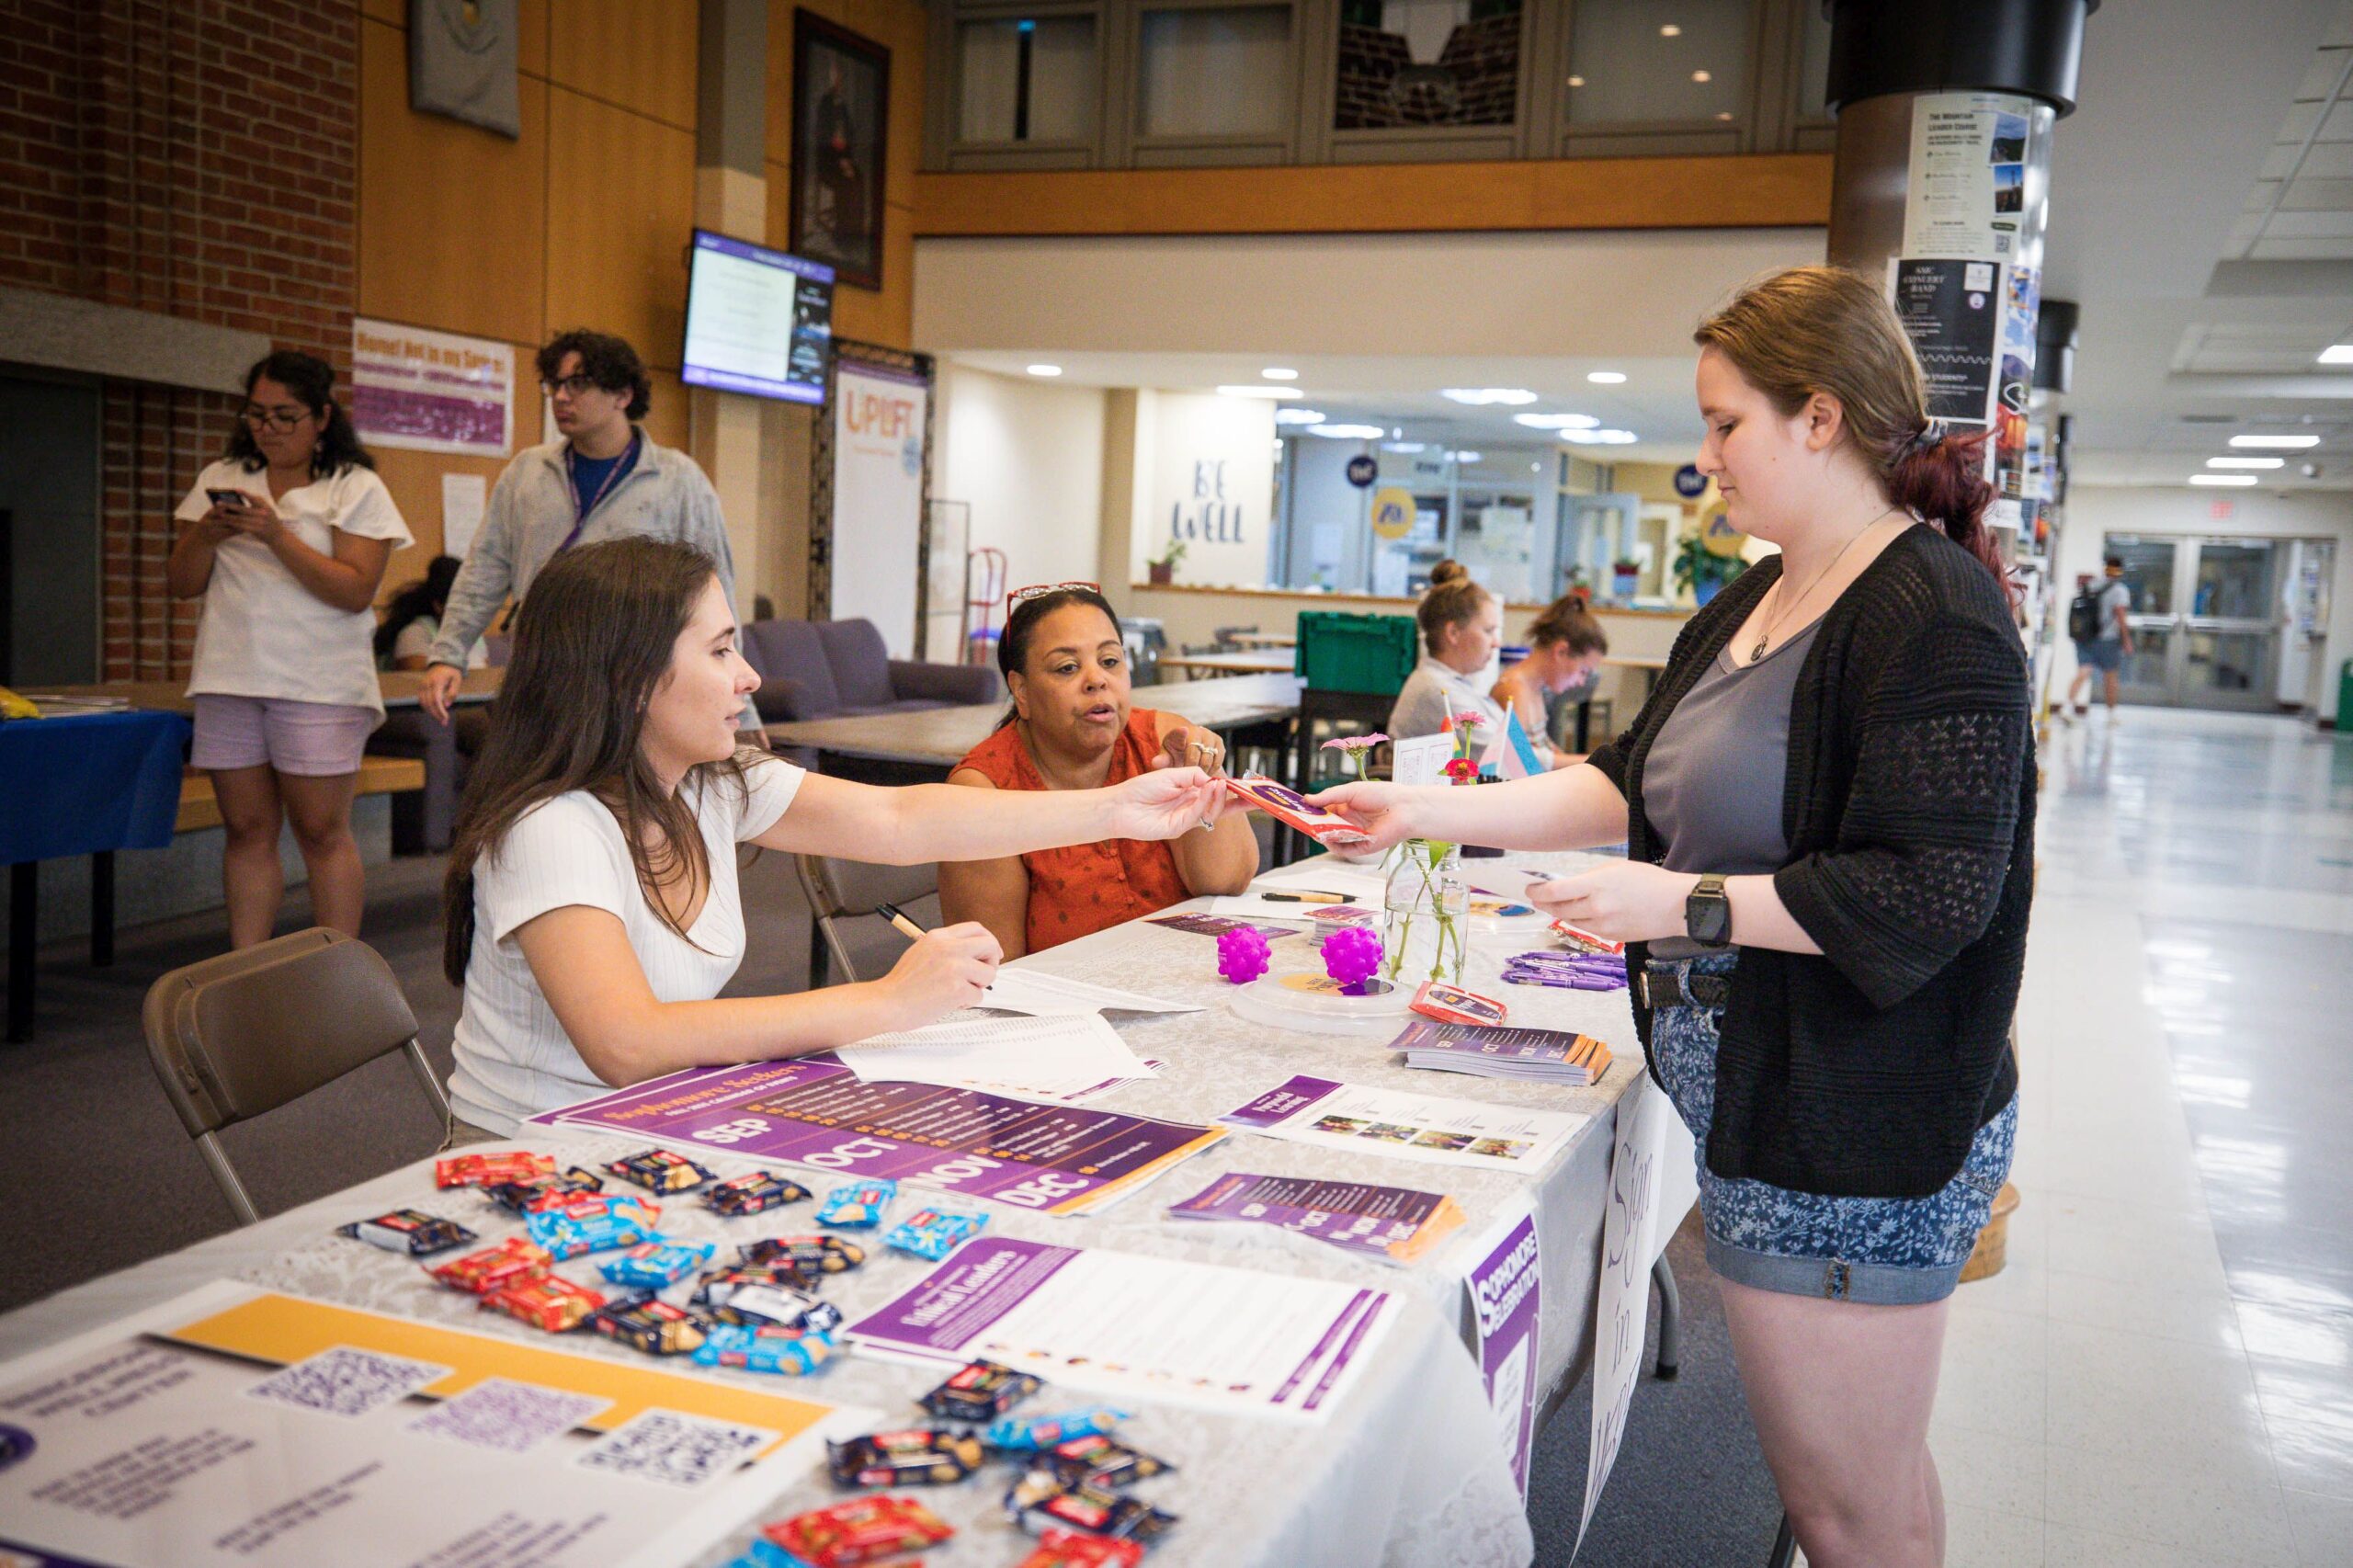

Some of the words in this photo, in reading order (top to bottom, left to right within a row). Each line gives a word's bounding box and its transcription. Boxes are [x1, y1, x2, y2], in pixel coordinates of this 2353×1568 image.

[1194, 459, 1228, 500] BE
[1172, 500, 1245, 542] WELL
[603, 1086, 732, 1121] Sophomore
[722, 1065, 807, 1088] Seekers
[691, 1118, 772, 1144] SEP
[802, 1137, 898, 1168] OCT
[896, 1154, 1004, 1189] NOV
[994, 1173, 1091, 1209] DEC
[1608, 1141, 1654, 1289] Sign
[1477, 1231, 1537, 1337] SOPHOMORE
[1612, 1296, 1631, 1376] in
